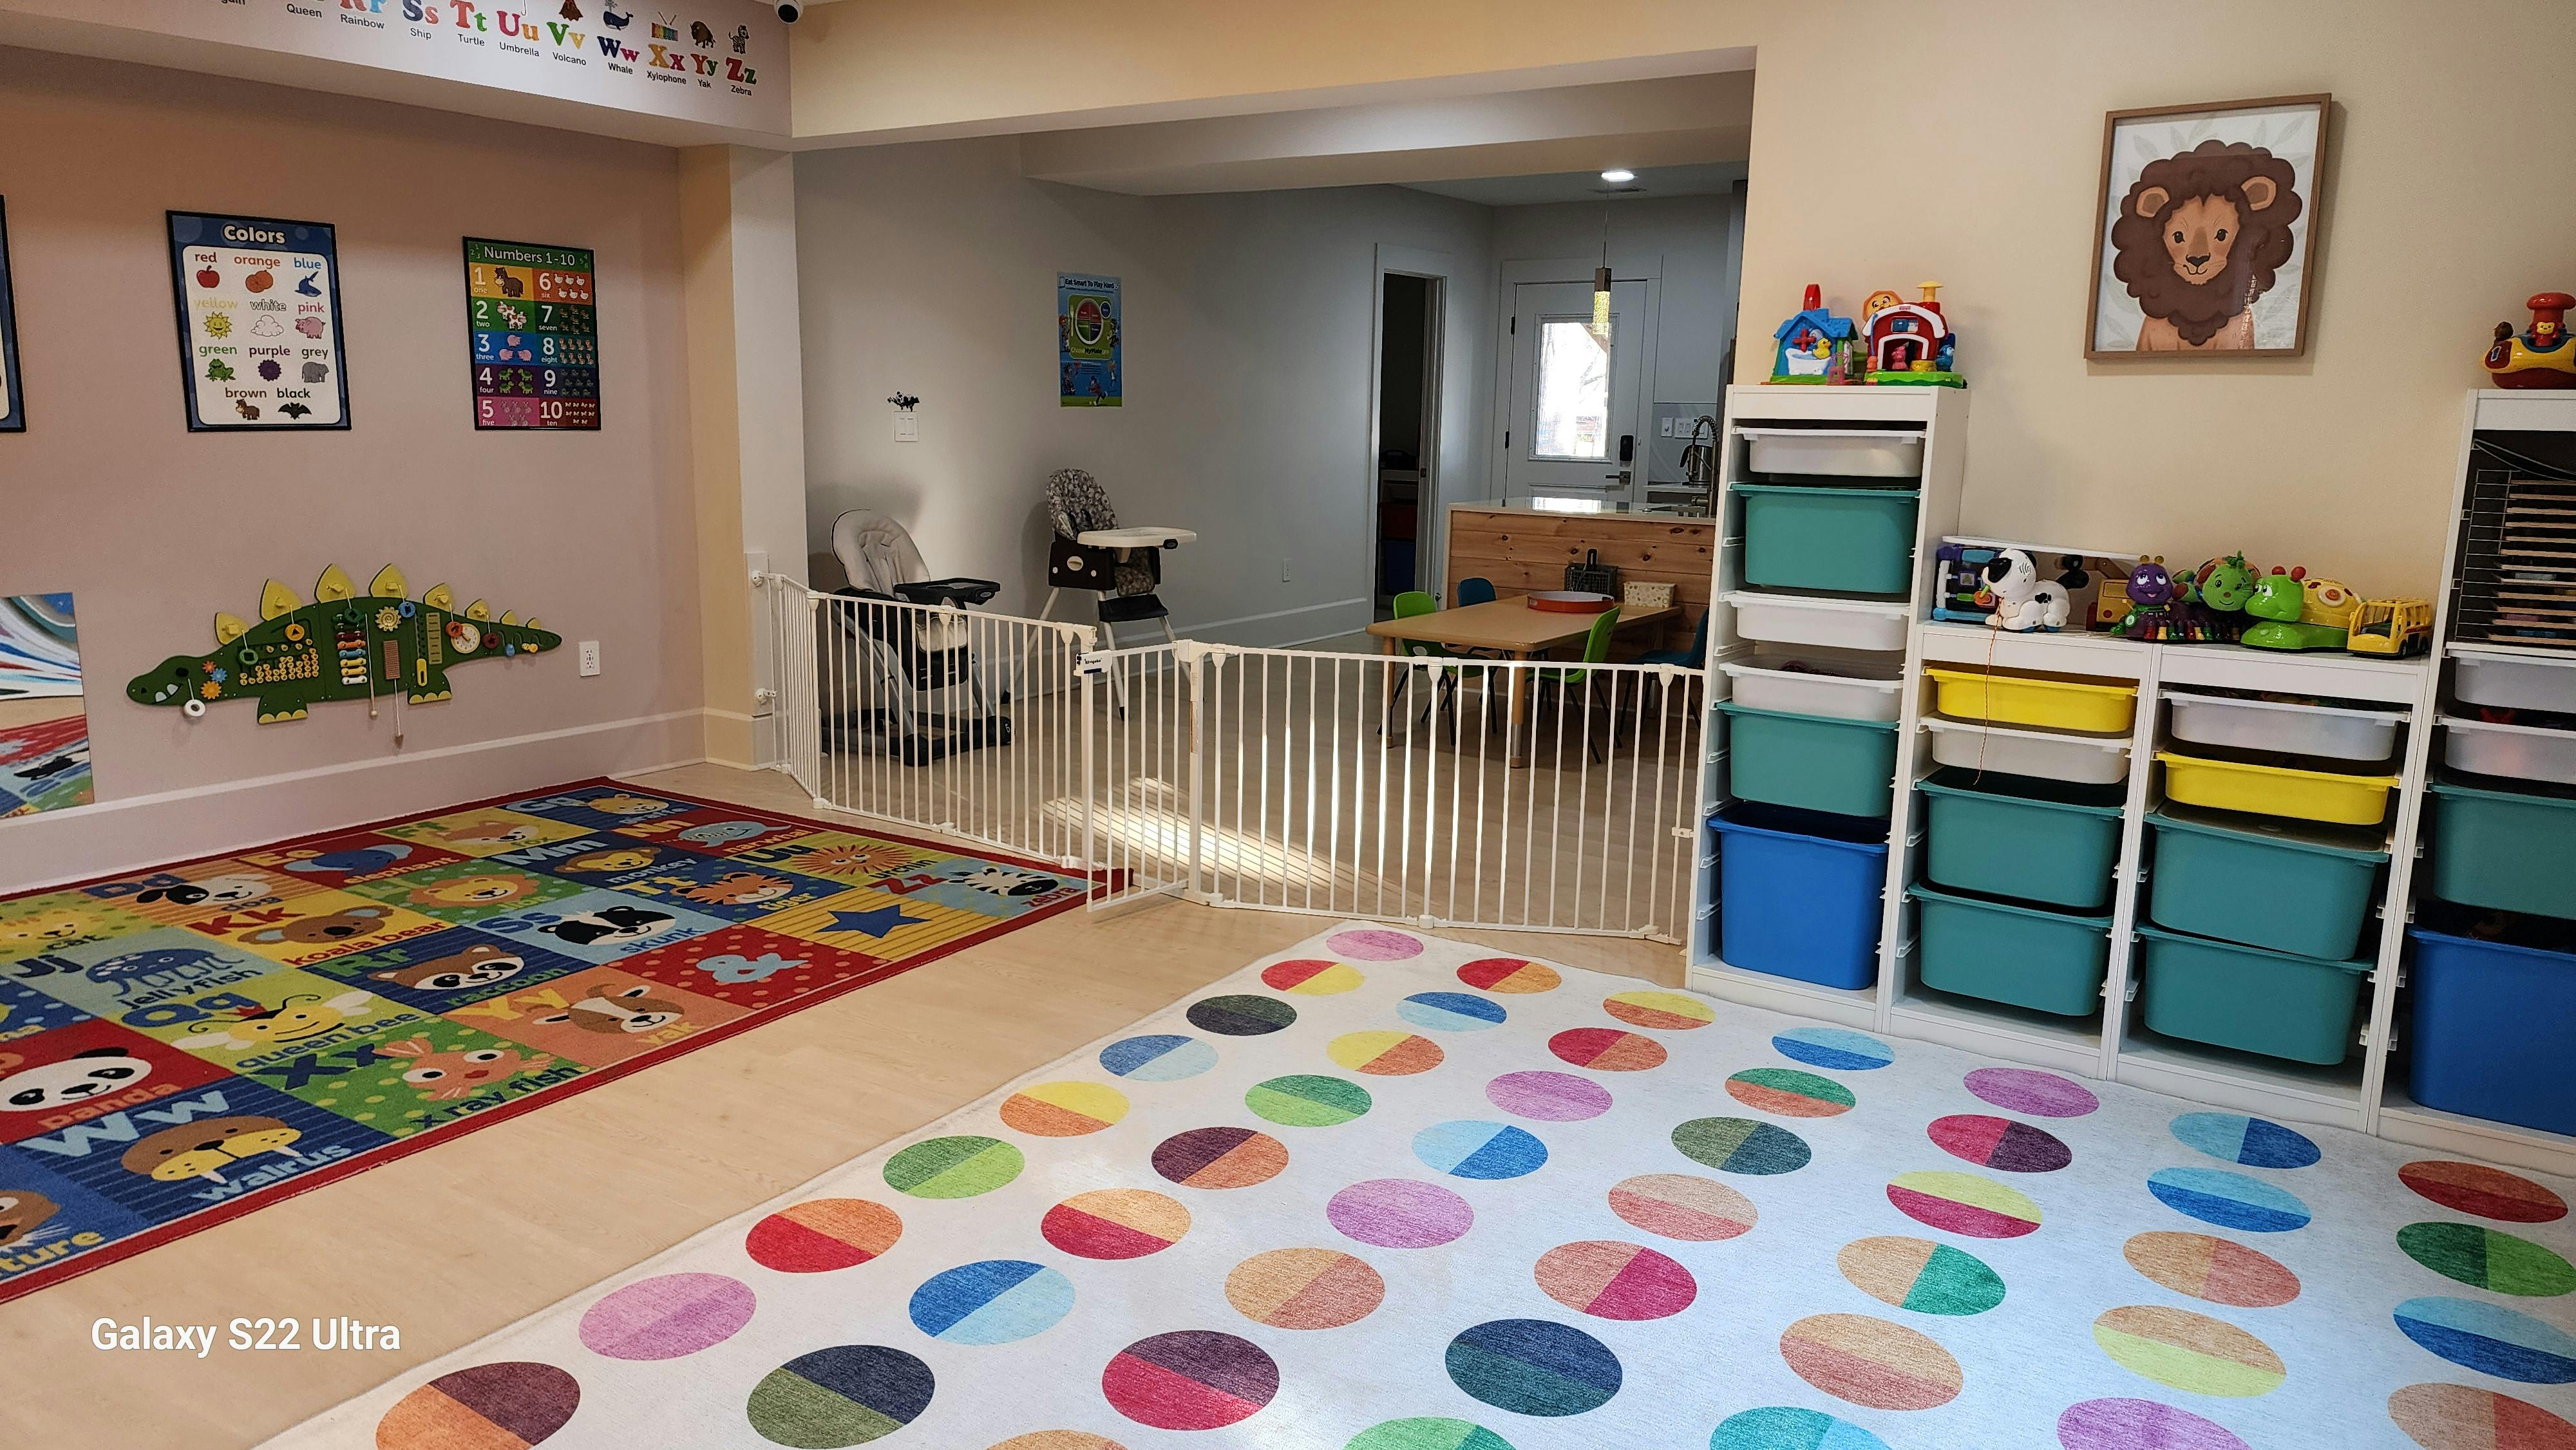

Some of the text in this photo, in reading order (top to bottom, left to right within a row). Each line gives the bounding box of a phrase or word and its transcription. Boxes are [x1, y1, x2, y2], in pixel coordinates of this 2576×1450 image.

[287, 4, 322, 18] Queen
[403, 0, 439, 24] Ss
[450, 1, 487, 32] Tt
[340, 14, 384, 29] Rainbow
[497, 10, 539, 41] Uu
[410, 28, 431, 41] Ship
[458, 33, 485, 47] Turtle
[547, 21, 585, 50] Vv
[499, 41, 540, 57] Umbrella
[597, 35, 639, 62] Ww
[648, 44, 685, 71] Xx
[553, 52, 587, 66] Volcano
[608, 62, 633, 75] Whale
[691, 53, 719, 76] Yy
[647, 70, 687, 86] Xylophone
[726, 57, 757, 84] Zz
[697, 79, 712, 89] Yak
[731, 84, 752, 97] Zebra
[224, 225, 285, 245] Colors
[195, 252, 217, 263] red
[234, 256, 281, 269] orange
[294, 258, 321, 269] blue
[484, 246, 575, 266] Numbers 1-10
[474, 267, 486, 286] 1
[539, 273, 551, 291] 6
[194, 297, 238, 310] yellow
[250, 299, 287, 312] white
[298, 302, 325, 314] pink
[476, 300, 488, 319] 2
[541, 305, 553, 323] 7
[199, 344, 237, 355] green
[249, 345, 290, 358] purple
[478, 334, 489, 352] 3
[542, 337, 554, 355] 8
[301, 348, 328, 360] grey
[479, 367, 493, 385] 4
[544, 370, 556, 388] 9
[225, 388, 267, 399] brown
[277, 388, 310, 399] black
[482, 400, 494, 419] 5
[541, 401, 563, 419] 10
[611, 820, 696, 838] Nn
[723, 829, 814, 853] narwhal
[242, 849, 325, 867] Ee
[494, 840, 609, 865] Mm
[733, 844, 820, 863] Uu
[343, 856, 460, 885] elephant
[605, 856, 699, 884] monkey
[869, 859, 938, 880] urchin
[611, 874, 699, 896] Tt
[865, 873, 948, 896] Zz
[756, 892, 818, 911] tiger
[1021, 887, 1081, 907] zebra
[185, 907, 307, 936] Kk
[477, 912, 562, 934] Ss
[46, 934, 109, 950] cat
[281, 920, 448, 966] koala bear
[620, 926, 707, 954] skunk
[321, 948, 412, 977] Rr
[443, 968, 570, 1007] raccoon
[449, 988, 571, 1021] Yy
[236, 1012, 421, 1069] queen bee
[636, 1021, 707, 1046] yak
[249, 1042, 394, 1091] Xx
[410, 1064, 579, 1128] x ray fish
[37, 1082, 183, 1130] panda
[14, 1089, 231, 1158] Ww
[192, 1145, 352, 1200] walrus
[0, 1232, 106, 1272] ture
